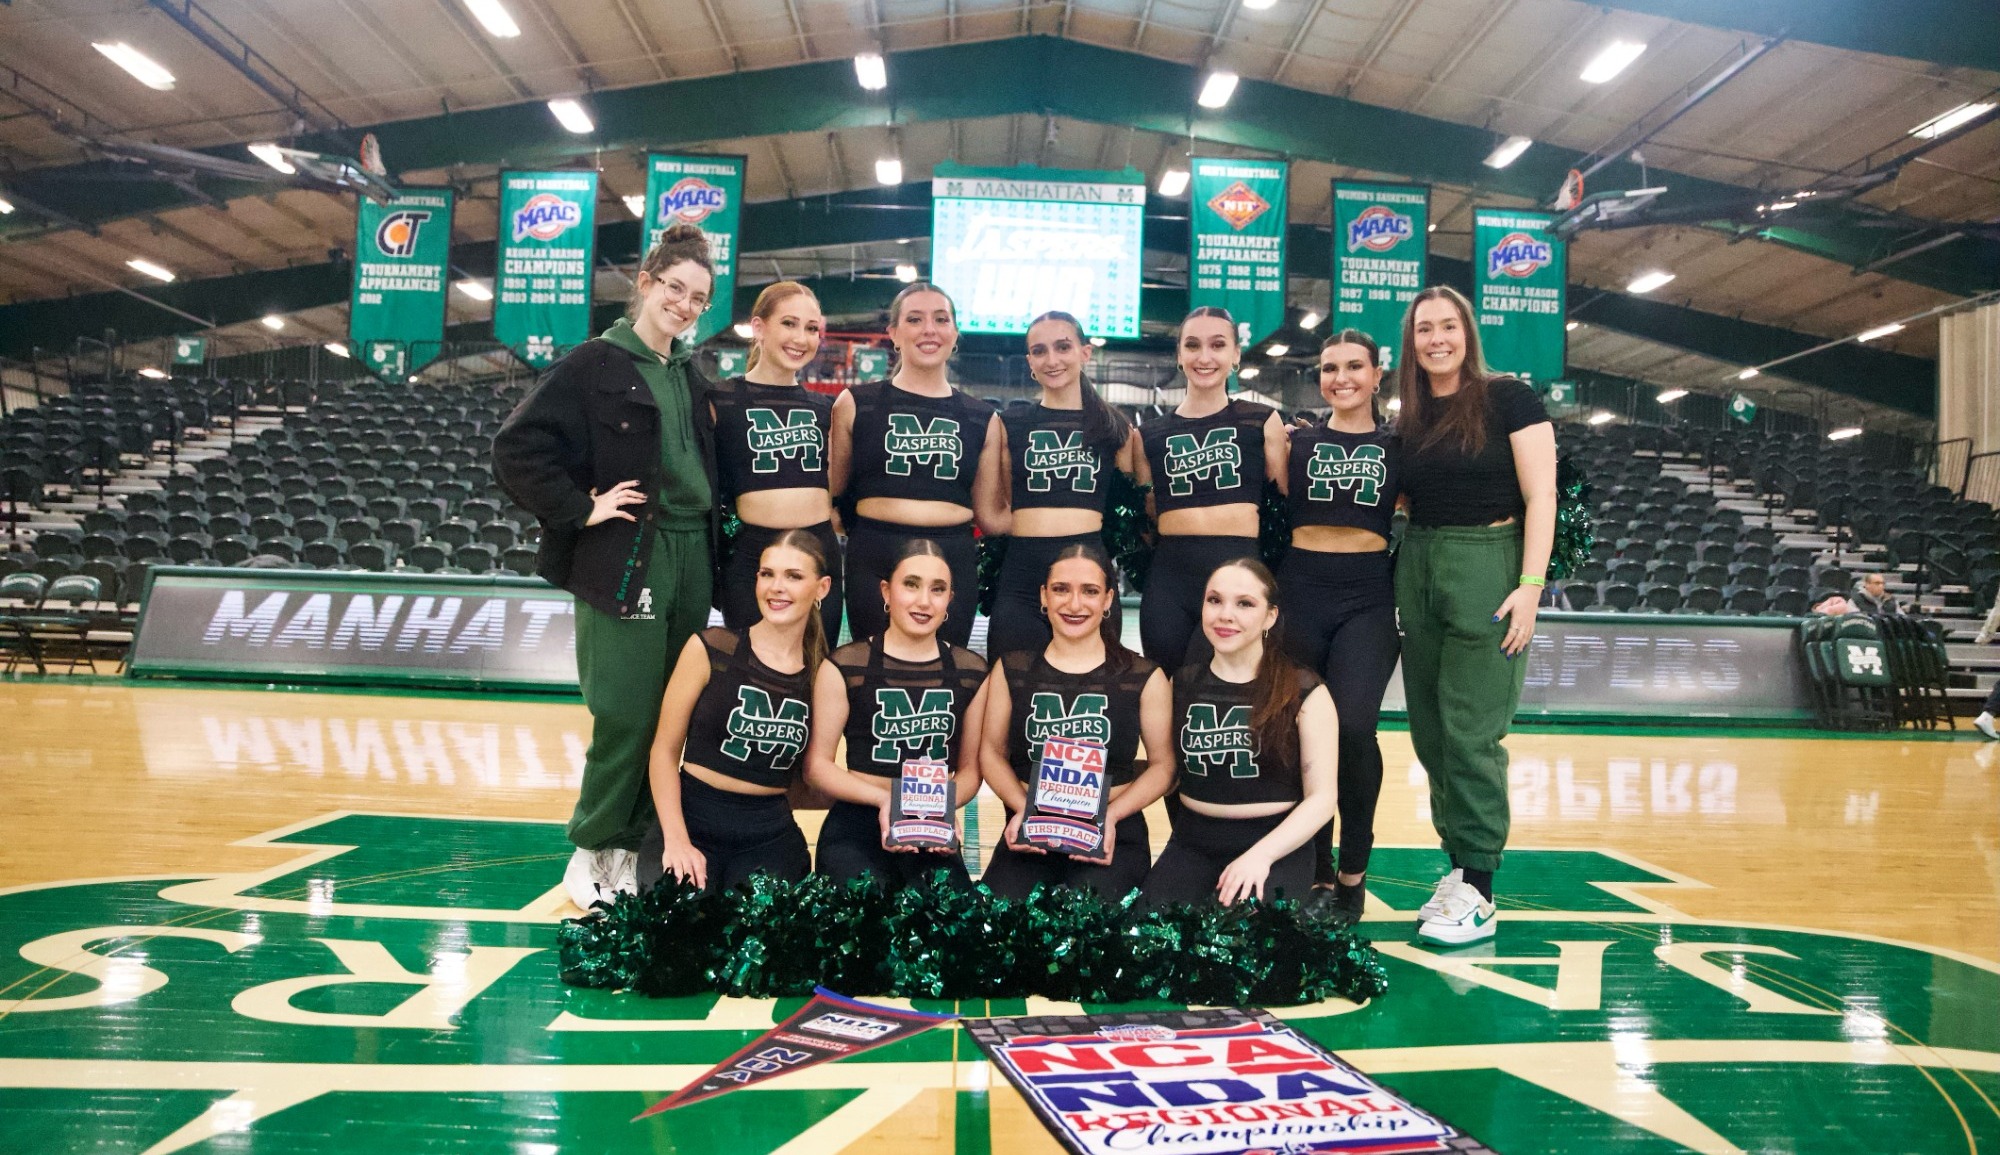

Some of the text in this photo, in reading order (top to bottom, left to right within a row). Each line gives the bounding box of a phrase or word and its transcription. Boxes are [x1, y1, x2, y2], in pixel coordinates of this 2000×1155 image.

[655, 162, 736, 175] MEN'S BASKETBALL
[1199, 165, 1280, 179] MEN'S BASKETBALL
[507, 179, 590, 191] MEN'S BASKETBALL
[975, 182, 1103, 201] MANHATTAN
[393, 196, 445, 208] BASKETBALL
[663, 189, 721, 217] MAAC
[1336, 190, 1425, 204] WOMEN'S BASKETBALL
[1223, 201, 1256, 211] NIT
[518, 205, 576, 235] MAAC
[1477, 216, 1551, 230] WOMEN'S BASKET
[1351, 218, 1408, 245] MAAC
[1197, 234, 1280, 249] TOURNAMENT
[506, 248, 585, 259] REGULAR SEASON
[1197, 248, 1280, 262] APPEARANCES
[1491, 245, 1547, 272] MAAC
[360, 263, 441, 278] TOURNAMENT
[505, 260, 584, 275] CHAMPIONS
[1341, 257, 1419, 273] TOURNAMENT
[359, 277, 441, 291] APPEARANCES
[1341, 270, 1419, 287] CHAMPIONS
[1483, 285, 1559, 299] REGULAR SEASON
[1482, 297, 1559, 314] CHAMPIONS
[756, 429, 818, 448] JASPERS
[892, 437, 957, 451] JASPERS
[1031, 448, 1095, 466] JASPERS
[1171, 447, 1234, 472] JASPERS
[1313, 462, 1381, 477] JASPERS
[203, 590, 576, 654] MANHAT
[1525, 635, 1742, 691] SPERS
[734, 720, 804, 743] JASPERS
[880, 717, 949, 735] JASPERS
[1032, 718, 1103, 739] JASPERS
[1186, 732, 1253, 749] JASPERS
[1044, 742, 1103, 765] NCA
[903, 765, 946, 778] NCA
[1041, 765, 1099, 788] NDA
[903, 783, 945, 795] NDA
[1040, 781, 1099, 798] REGIONAL
[1042, 789, 1092, 807] Champion
[923, 828, 949, 837] PLACE
[1027, 825, 1097, 844] FIRST PLACE
[820, 1015, 888, 1031] NDA
[1007, 1038, 1310, 1073] NCA
[715, 1047, 812, 1083] NDA
[1045, 1072, 1371, 1111] NDA
[1066, 1098, 1400, 1132] REGIONAL
[1103, 1113, 1410, 1150] Championship
